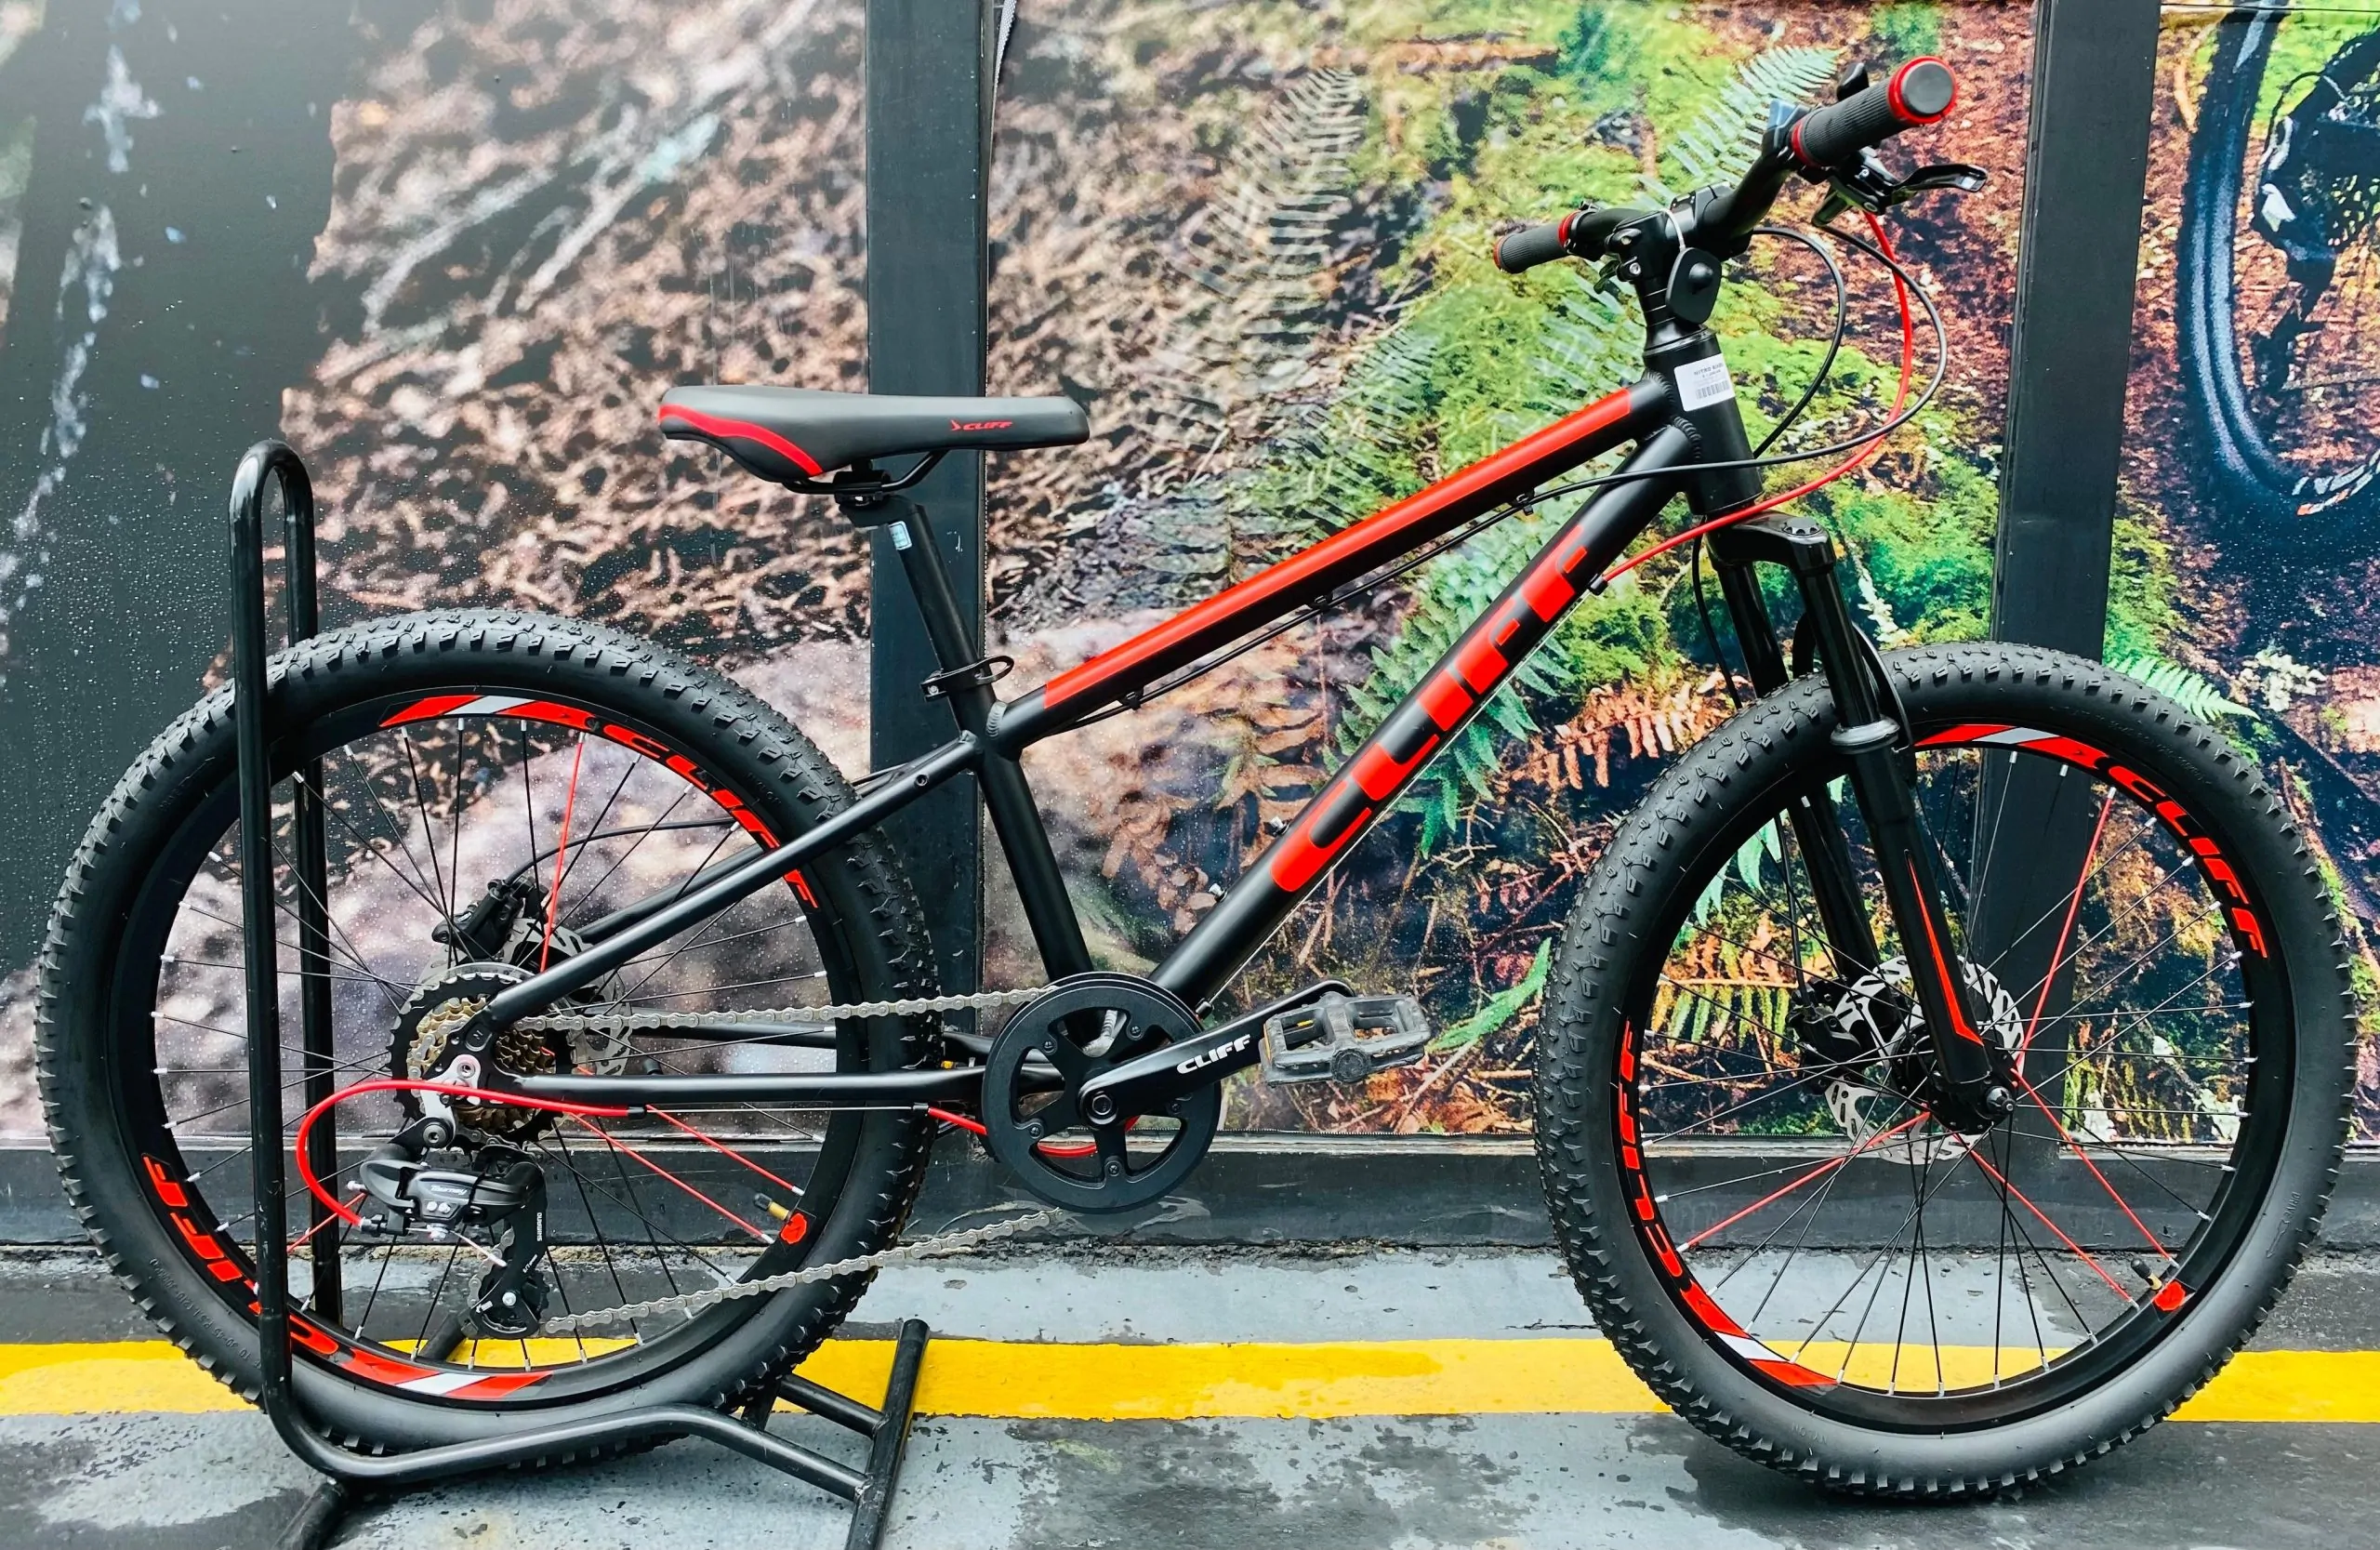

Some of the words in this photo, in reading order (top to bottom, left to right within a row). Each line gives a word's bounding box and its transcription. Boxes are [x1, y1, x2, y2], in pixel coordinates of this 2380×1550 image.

[962, 421, 1012, 431] CLIFF
[1271, 524, 1587, 892] CLIFF
[2108, 765, 2268, 959] CLIFF
[1177, 1034, 1250, 1074] CLIFF
[1619, 1020, 1683, 1278] CLIFF
